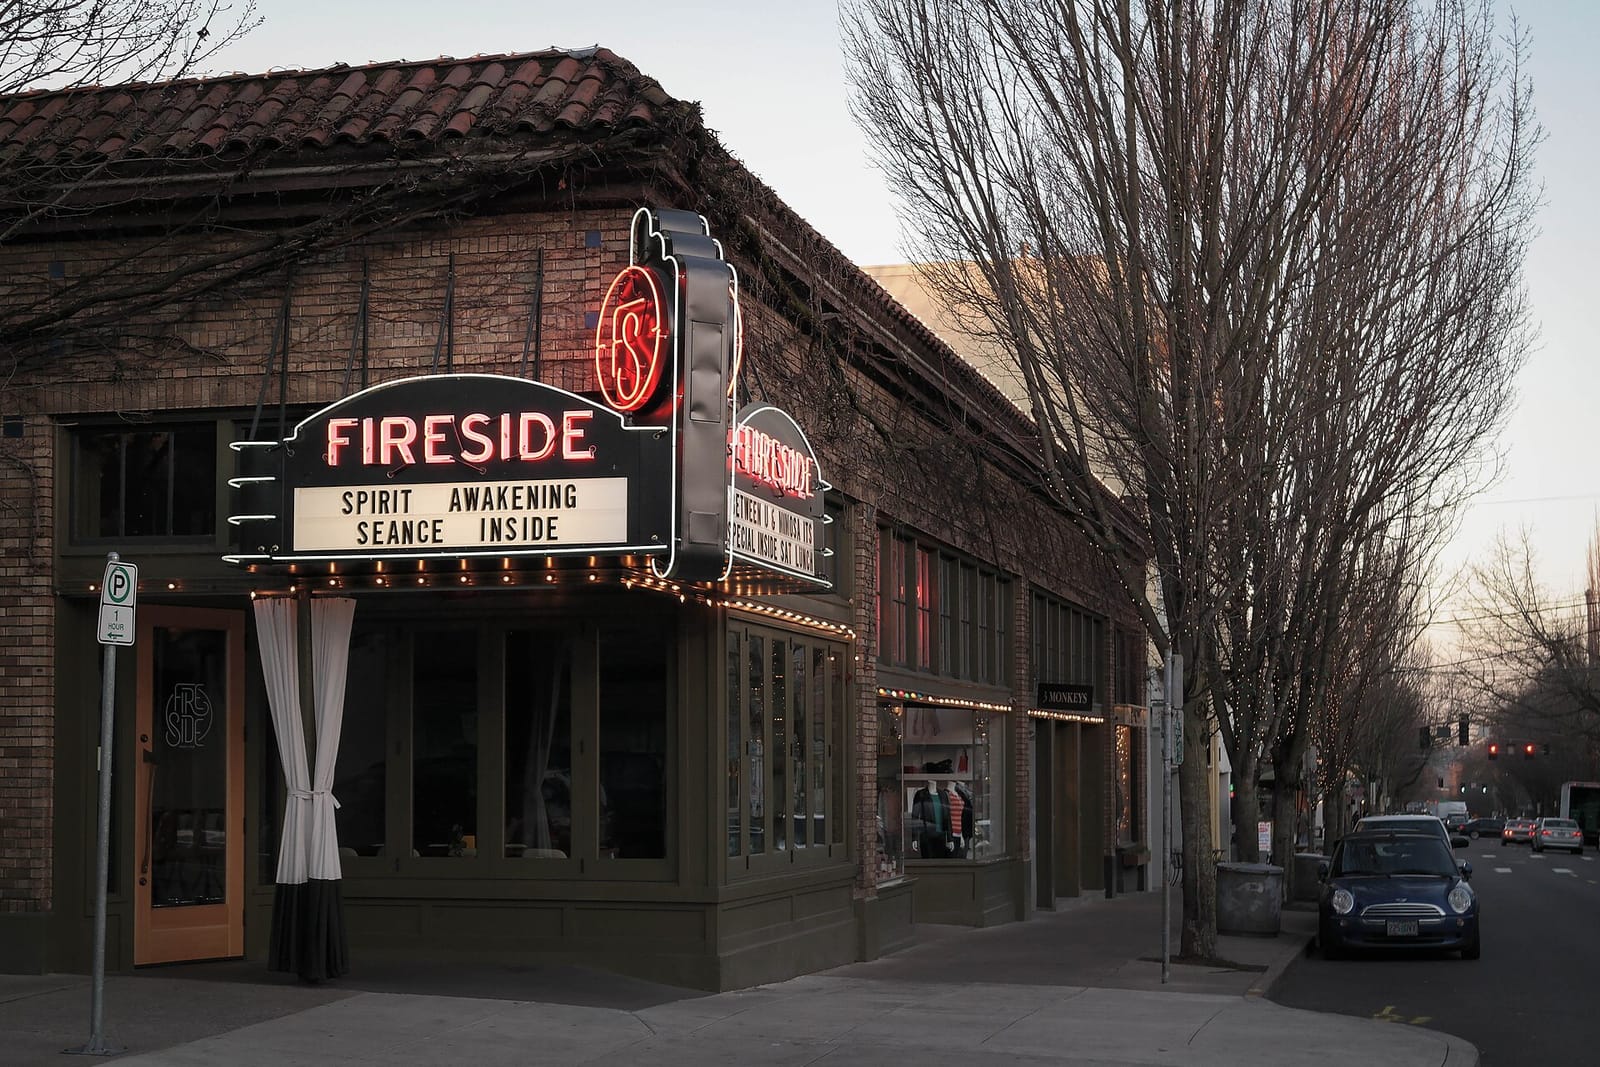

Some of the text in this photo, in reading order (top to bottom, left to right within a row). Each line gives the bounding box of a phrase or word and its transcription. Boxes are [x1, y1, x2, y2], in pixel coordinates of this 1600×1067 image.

[326, 409, 596, 467] FIRESIDE
[736, 424, 815, 498] FIRESIDE
[341, 484, 578, 515] SPIRIT AWAKENING
[732, 492, 762, 526] ETWEEN
[356, 516, 560, 545] SEANCE INSIDE
[757, 531, 778, 561] INSIDE
[780, 539, 792, 565] SAT
[113, 574, 125, 597] P
[108, 623, 125, 631] HOUR
[113, 610, 119, 622] 1
[174, 682, 209, 717] FIRE
[1048, 691, 1088, 705] MONKEYS
[165, 711, 206, 747] SIDE
